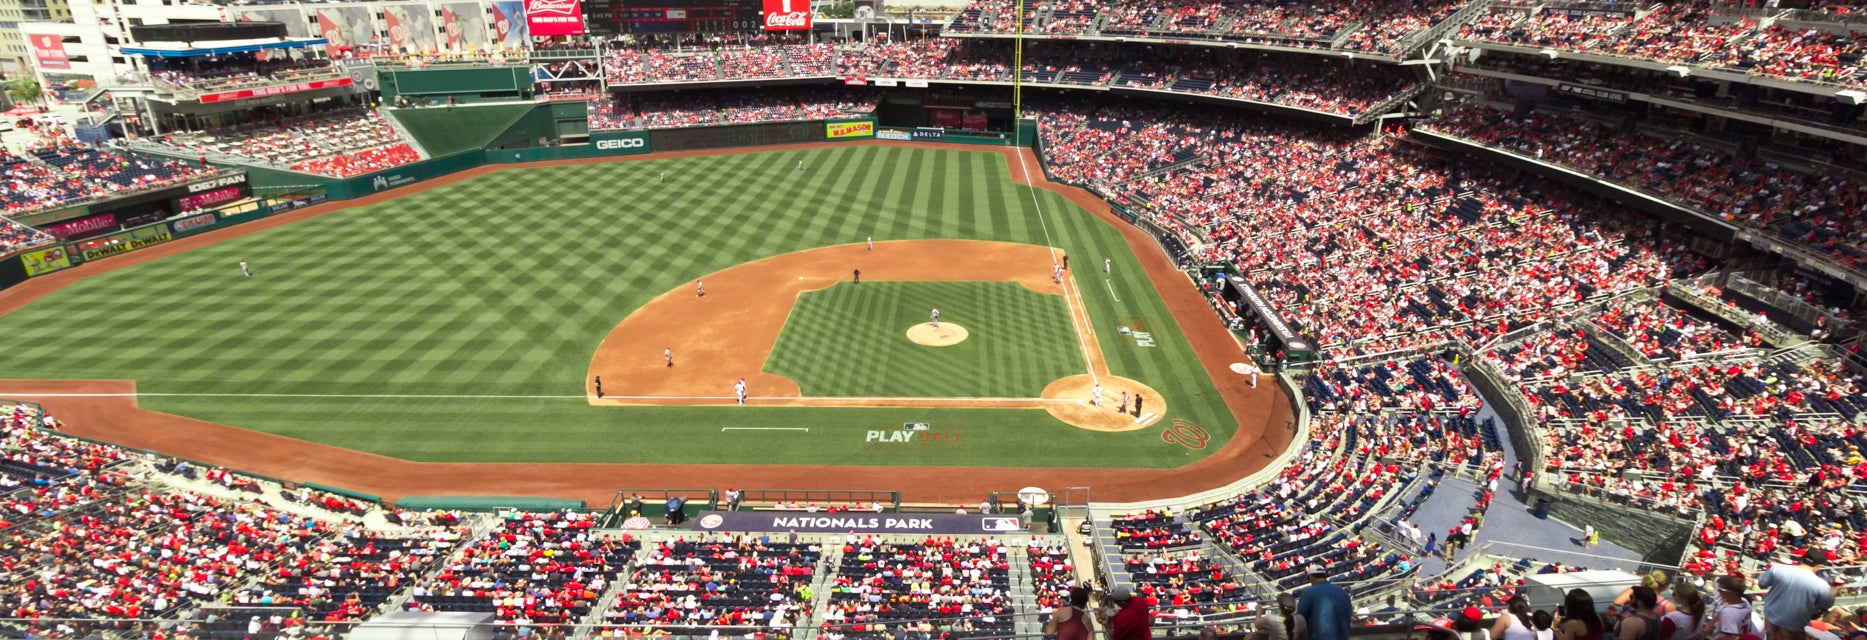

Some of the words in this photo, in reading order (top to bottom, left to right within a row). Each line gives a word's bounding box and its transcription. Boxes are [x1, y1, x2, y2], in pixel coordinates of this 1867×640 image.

[766, 11, 808, 26] Coca-Cola
[596, 138, 644, 149] GEICO
[218, 174, 246, 186] FAN
[866, 430, 914, 442] PLAY
[772, 516, 879, 528] NATIONALS
[885, 518, 933, 529] PARK
